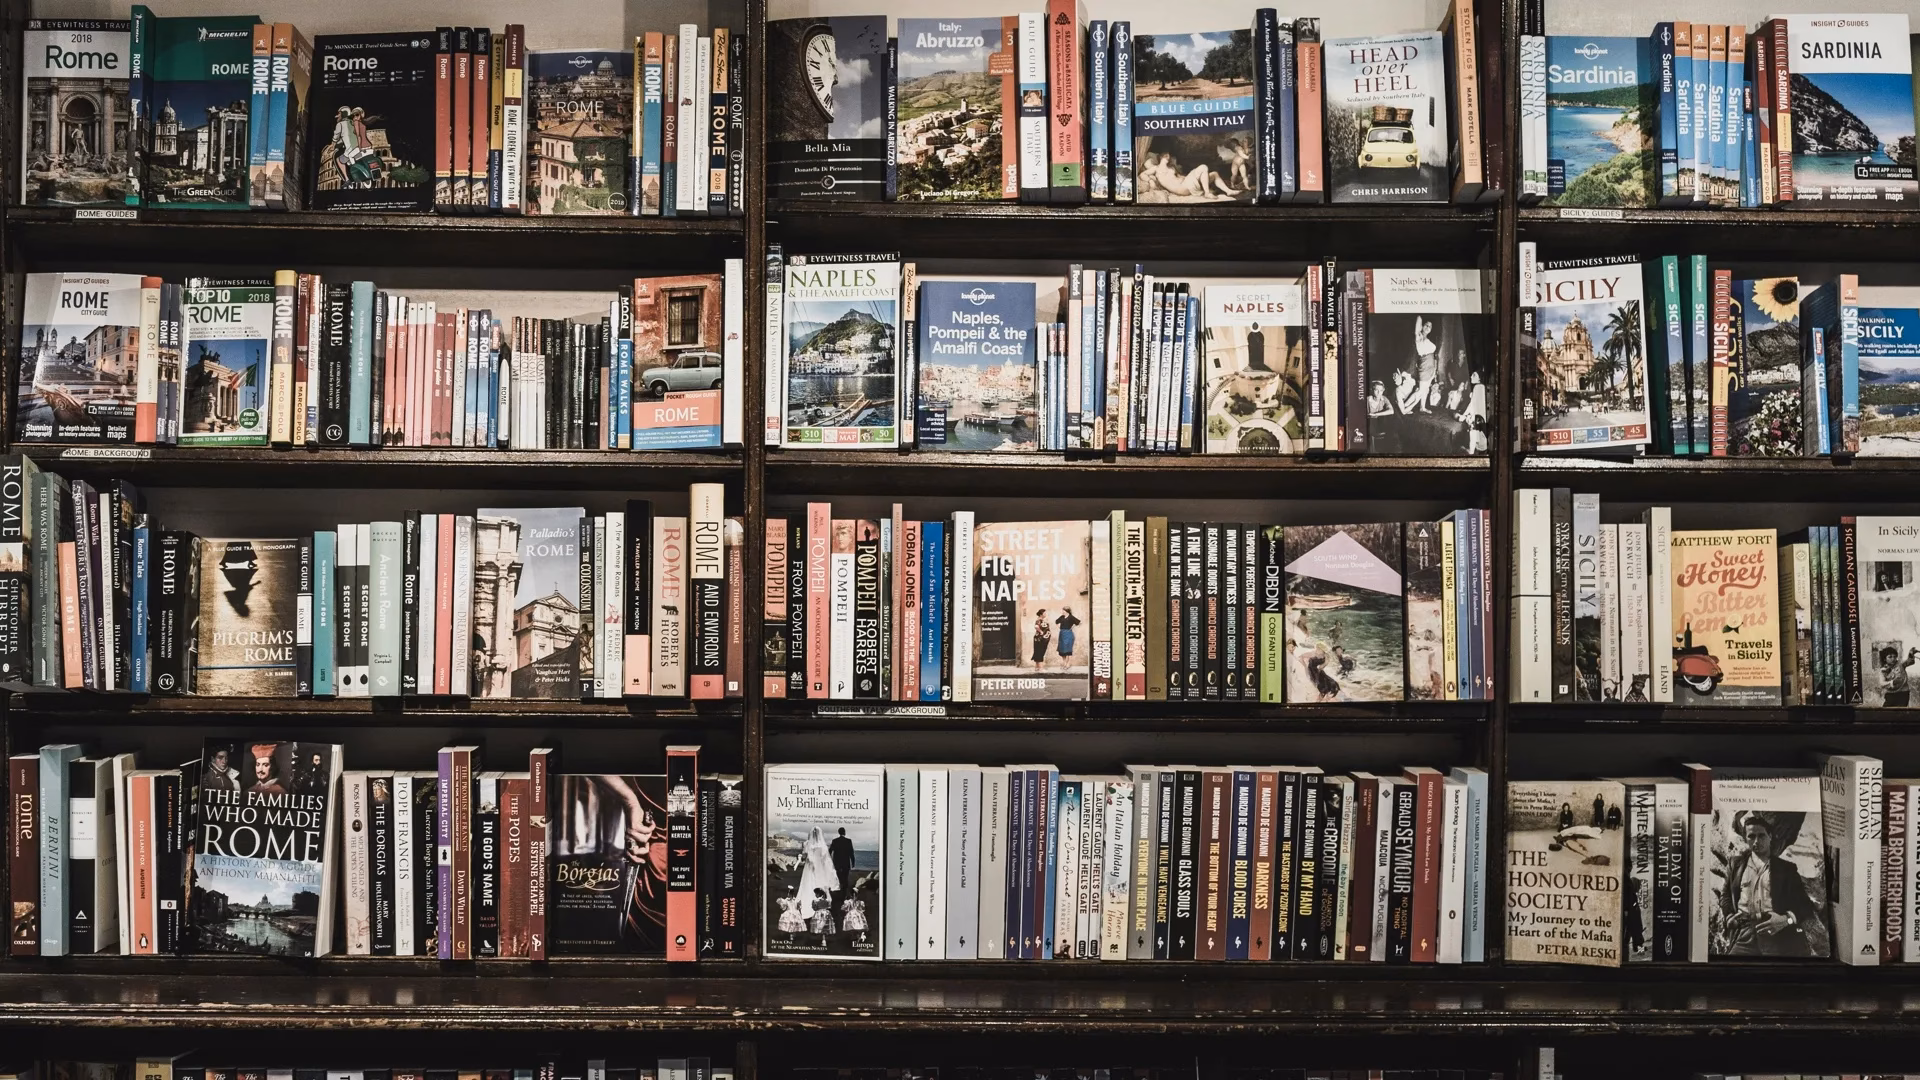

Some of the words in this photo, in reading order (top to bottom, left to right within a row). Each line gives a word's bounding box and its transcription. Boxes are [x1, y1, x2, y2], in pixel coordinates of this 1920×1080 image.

[208, 30, 248, 38] MICHELIN
[939, 23, 962, 33] Italy:
[71, 34, 92, 43] 2018
[916, 32, 984, 48] Abruzzo
[46, 45, 118, 70] Rome
[1350, 46, 1419, 65] HEAD
[1802, 42, 1882, 59] SARDINIA
[212, 63, 249, 75] ROME
[324, 56, 377, 70] Rome
[440, 58, 448, 79] Rome
[1362, 61, 1408, 76] over
[1095, 51, 1105, 99] Southern
[1354, 75, 1417, 93] HEEL
[1520, 41, 1534, 118] SARDINIA
[1548, 65, 1636, 84] Sardinia
[556, 101, 603, 114] ROME
[1093, 101, 1105, 125] Italy
[1152, 104, 1185, 114] BLUE
[1194, 101, 1239, 112] GUIDE
[1678, 80, 1690, 135] Sardinia
[713, 106, 725, 155] ROME
[888, 121, 895, 130] IN
[1144, 119, 1209, 130] SOUTHERN
[1213, 116, 1246, 126] ITALY
[805, 144, 828, 152] Bella
[832, 144, 851, 152] Mia
[887, 131, 895, 166] ABRUZZO
[1352, 188, 1379, 196] CHRIS
[1381, 186, 1428, 195] HARRISON
[811, 255, 863, 263] EYEWITNESS
[790, 269, 876, 288] NAPLES
[1391, 277, 1418, 286] Naples
[61, 291, 109, 309] ROME
[248, 294, 270, 302] 2018
[788, 290, 796, 298] &
[799, 288, 818, 297] THE
[820, 288, 860, 297] AMALFI
[862, 288, 896, 296] COAST
[189, 306, 242, 323] ROME
[1224, 303, 1284, 313] NAPLES
[331, 301, 343, 346] ROME
[952, 312, 1004, 326] Naples,
[1669, 304, 1679, 337] SICILY
[928, 326, 985, 341] Pompeii
[989, 327, 1000, 339] &
[1004, 326, 1027, 340] the
[1857, 326, 1904, 338] SICILY
[932, 341, 977, 355] Amalfi
[981, 342, 1023, 356] Coast
[654, 407, 699, 423] ROME
[3, 465, 21, 537] ROME
[530, 529, 575, 538] Palladio's
[980, 528, 1064, 551] STREET
[1879, 526, 1889, 535] In
[1892, 526, 1919, 536] Sicily
[695, 522, 719, 573] ROME
[1671, 537, 1734, 547] MATTHEW
[1737, 535, 1772, 545] FORT
[526, 545, 574, 557] ROME
[1711, 550, 1764, 568] Sweet
[662, 527, 681, 599] ROME
[980, 555, 1044, 577] FIGHT
[1053, 554, 1075, 575] IN
[1578, 534, 1596, 607] SICILY
[767, 542, 785, 605] POMPEII
[580, 563, 591, 611] COLOSSEUM
[704, 584, 718, 607] AND
[981, 579, 1066, 602] NAPLES
[1266, 566, 1279, 611] DIBDIN
[213, 630, 293, 646] PILGRIM'S
[661, 619, 669, 667] HUGHES
[670, 621, 679, 666] ROBERT
[704, 611, 719, 667] ENVIRONS
[856, 618, 866, 674] HARRIS
[866, 619, 877, 675] ROBERT
[1725, 639, 1773, 649] Travels
[244, 647, 293, 661] ROME
[1737, 650, 1773, 661] Sicily
[981, 679, 1014, 690] PETER
[1018, 678, 1045, 689] ROBB
[205, 789, 241, 806] THE
[248, 792, 324, 810] FAMILIES
[398, 782, 408, 816] POPE
[790, 785, 815, 796] Elena
[818, 786, 857, 796] Ferrante
[777, 796, 793, 810] My
[796, 797, 833, 810] Brilliant
[836, 798, 869, 810] Friend
[1859, 768, 1869, 840] SHADOWS
[1870, 767, 1882, 841] SICILIAN
[20, 794, 33, 840] rome
[205, 805, 257, 824] WHO
[264, 810, 321, 828] MADE
[1888, 791, 1905, 836] MAFIA
[483, 821, 493, 833] IN
[49, 816, 59, 879] BERNINI
[203, 824, 320, 863] ROME
[399, 822, 409, 880] FRANCIS
[483, 837, 493, 870] GOD'S
[1509, 850, 1548, 867] THE
[556, 863, 620, 883] Borgias
[1179, 860, 1192, 887] GLASS
[1508, 871, 1620, 892] HONOURED
[483, 875, 493, 906] NAME
[1255, 862, 1270, 910] DARKNESS
[1886, 839, 1904, 942] BROTHERHOODS
[1177, 889, 1190, 918] SOULS
[1508, 892, 1588, 911] SOCIETY
[1508, 912, 1528, 926] My
[1531, 912, 1575, 928] Journey
[1579, 917, 1591, 926] to
[1594, 916, 1612, 927] the
[1508, 926, 1541, 938] Heart
[1544, 928, 1557, 939] of
[1560, 928, 1577, 939] the
[1581, 929, 1613, 942] Mafia
[1537, 944, 1577, 956] PETRA
[1581, 947, 1617, 960] RESKI
